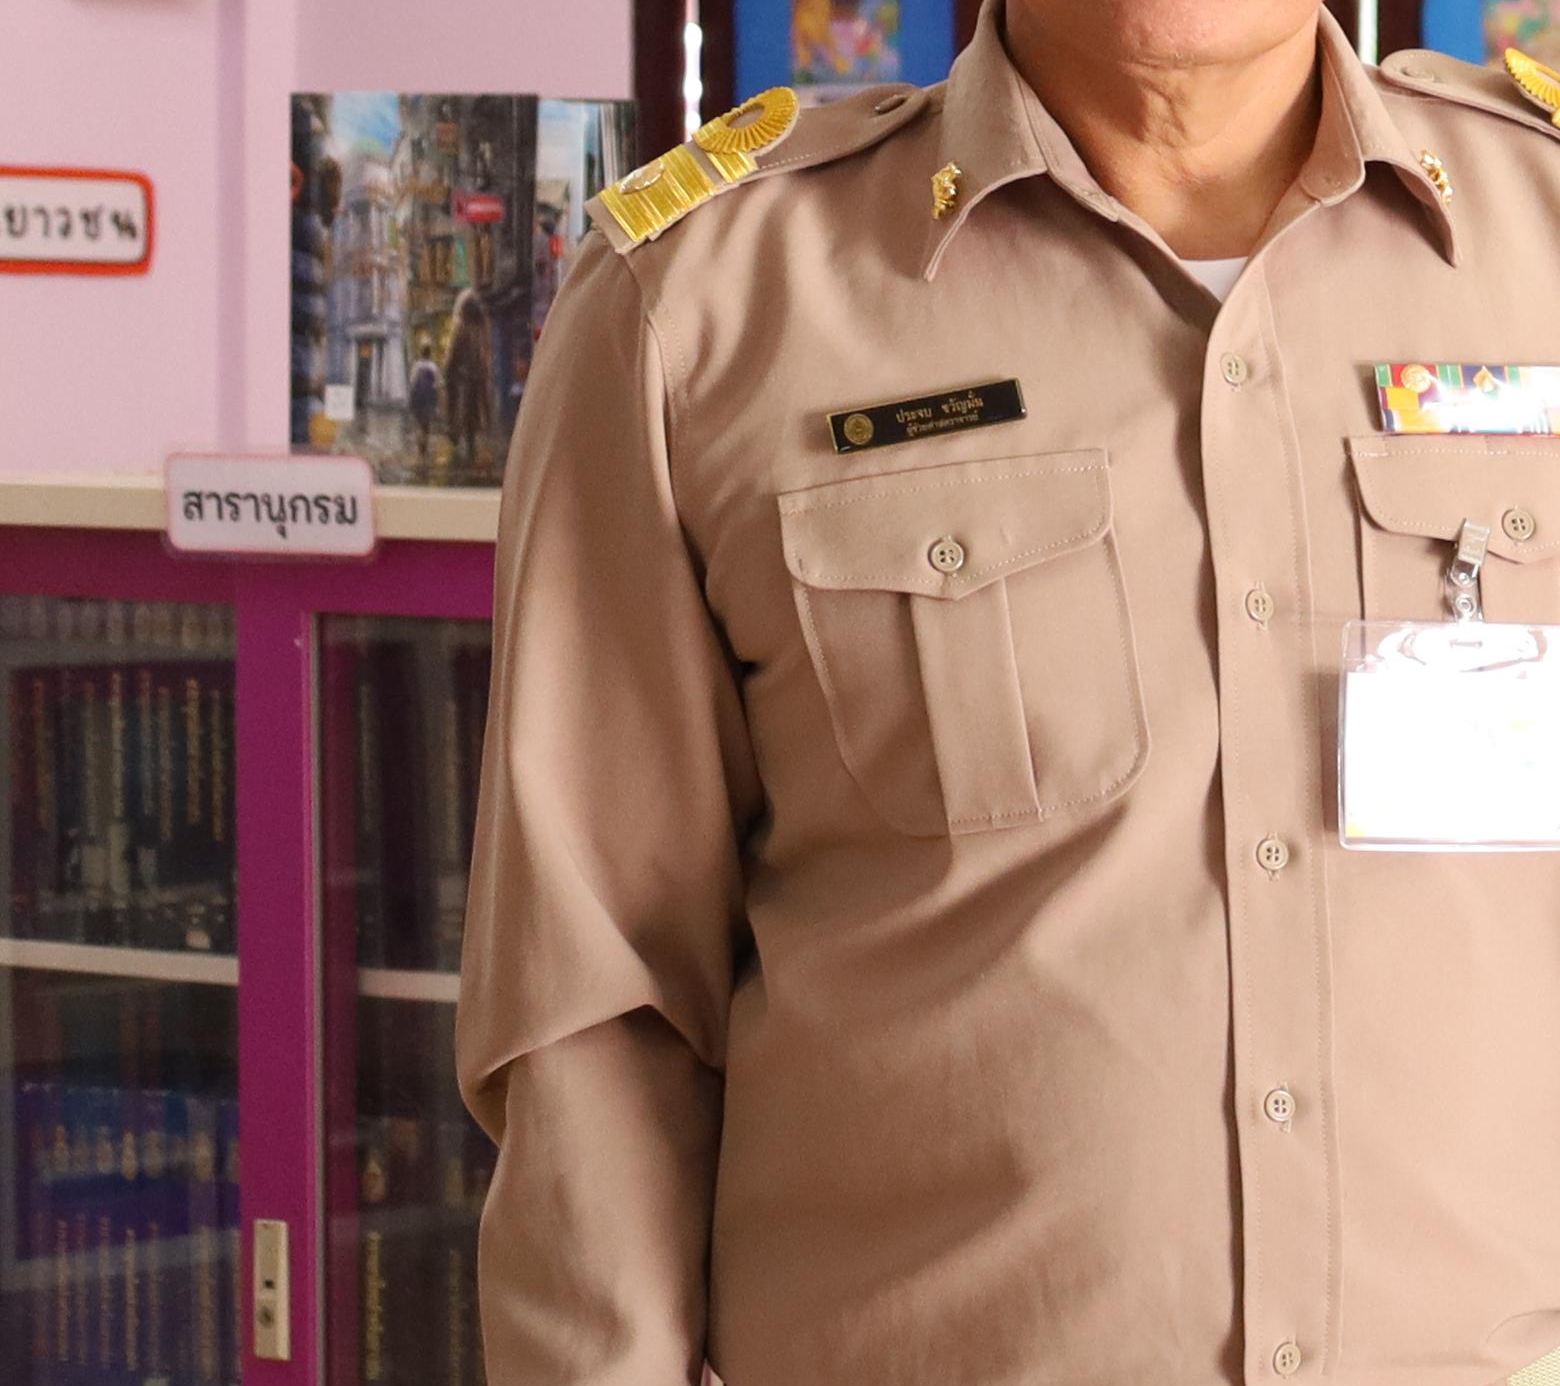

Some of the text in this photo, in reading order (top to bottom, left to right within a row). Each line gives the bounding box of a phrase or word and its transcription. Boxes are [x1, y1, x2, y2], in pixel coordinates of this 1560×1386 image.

[0, 204, 137, 242] ยาวชน
[182, 490, 358, 538] สารานุกรม
